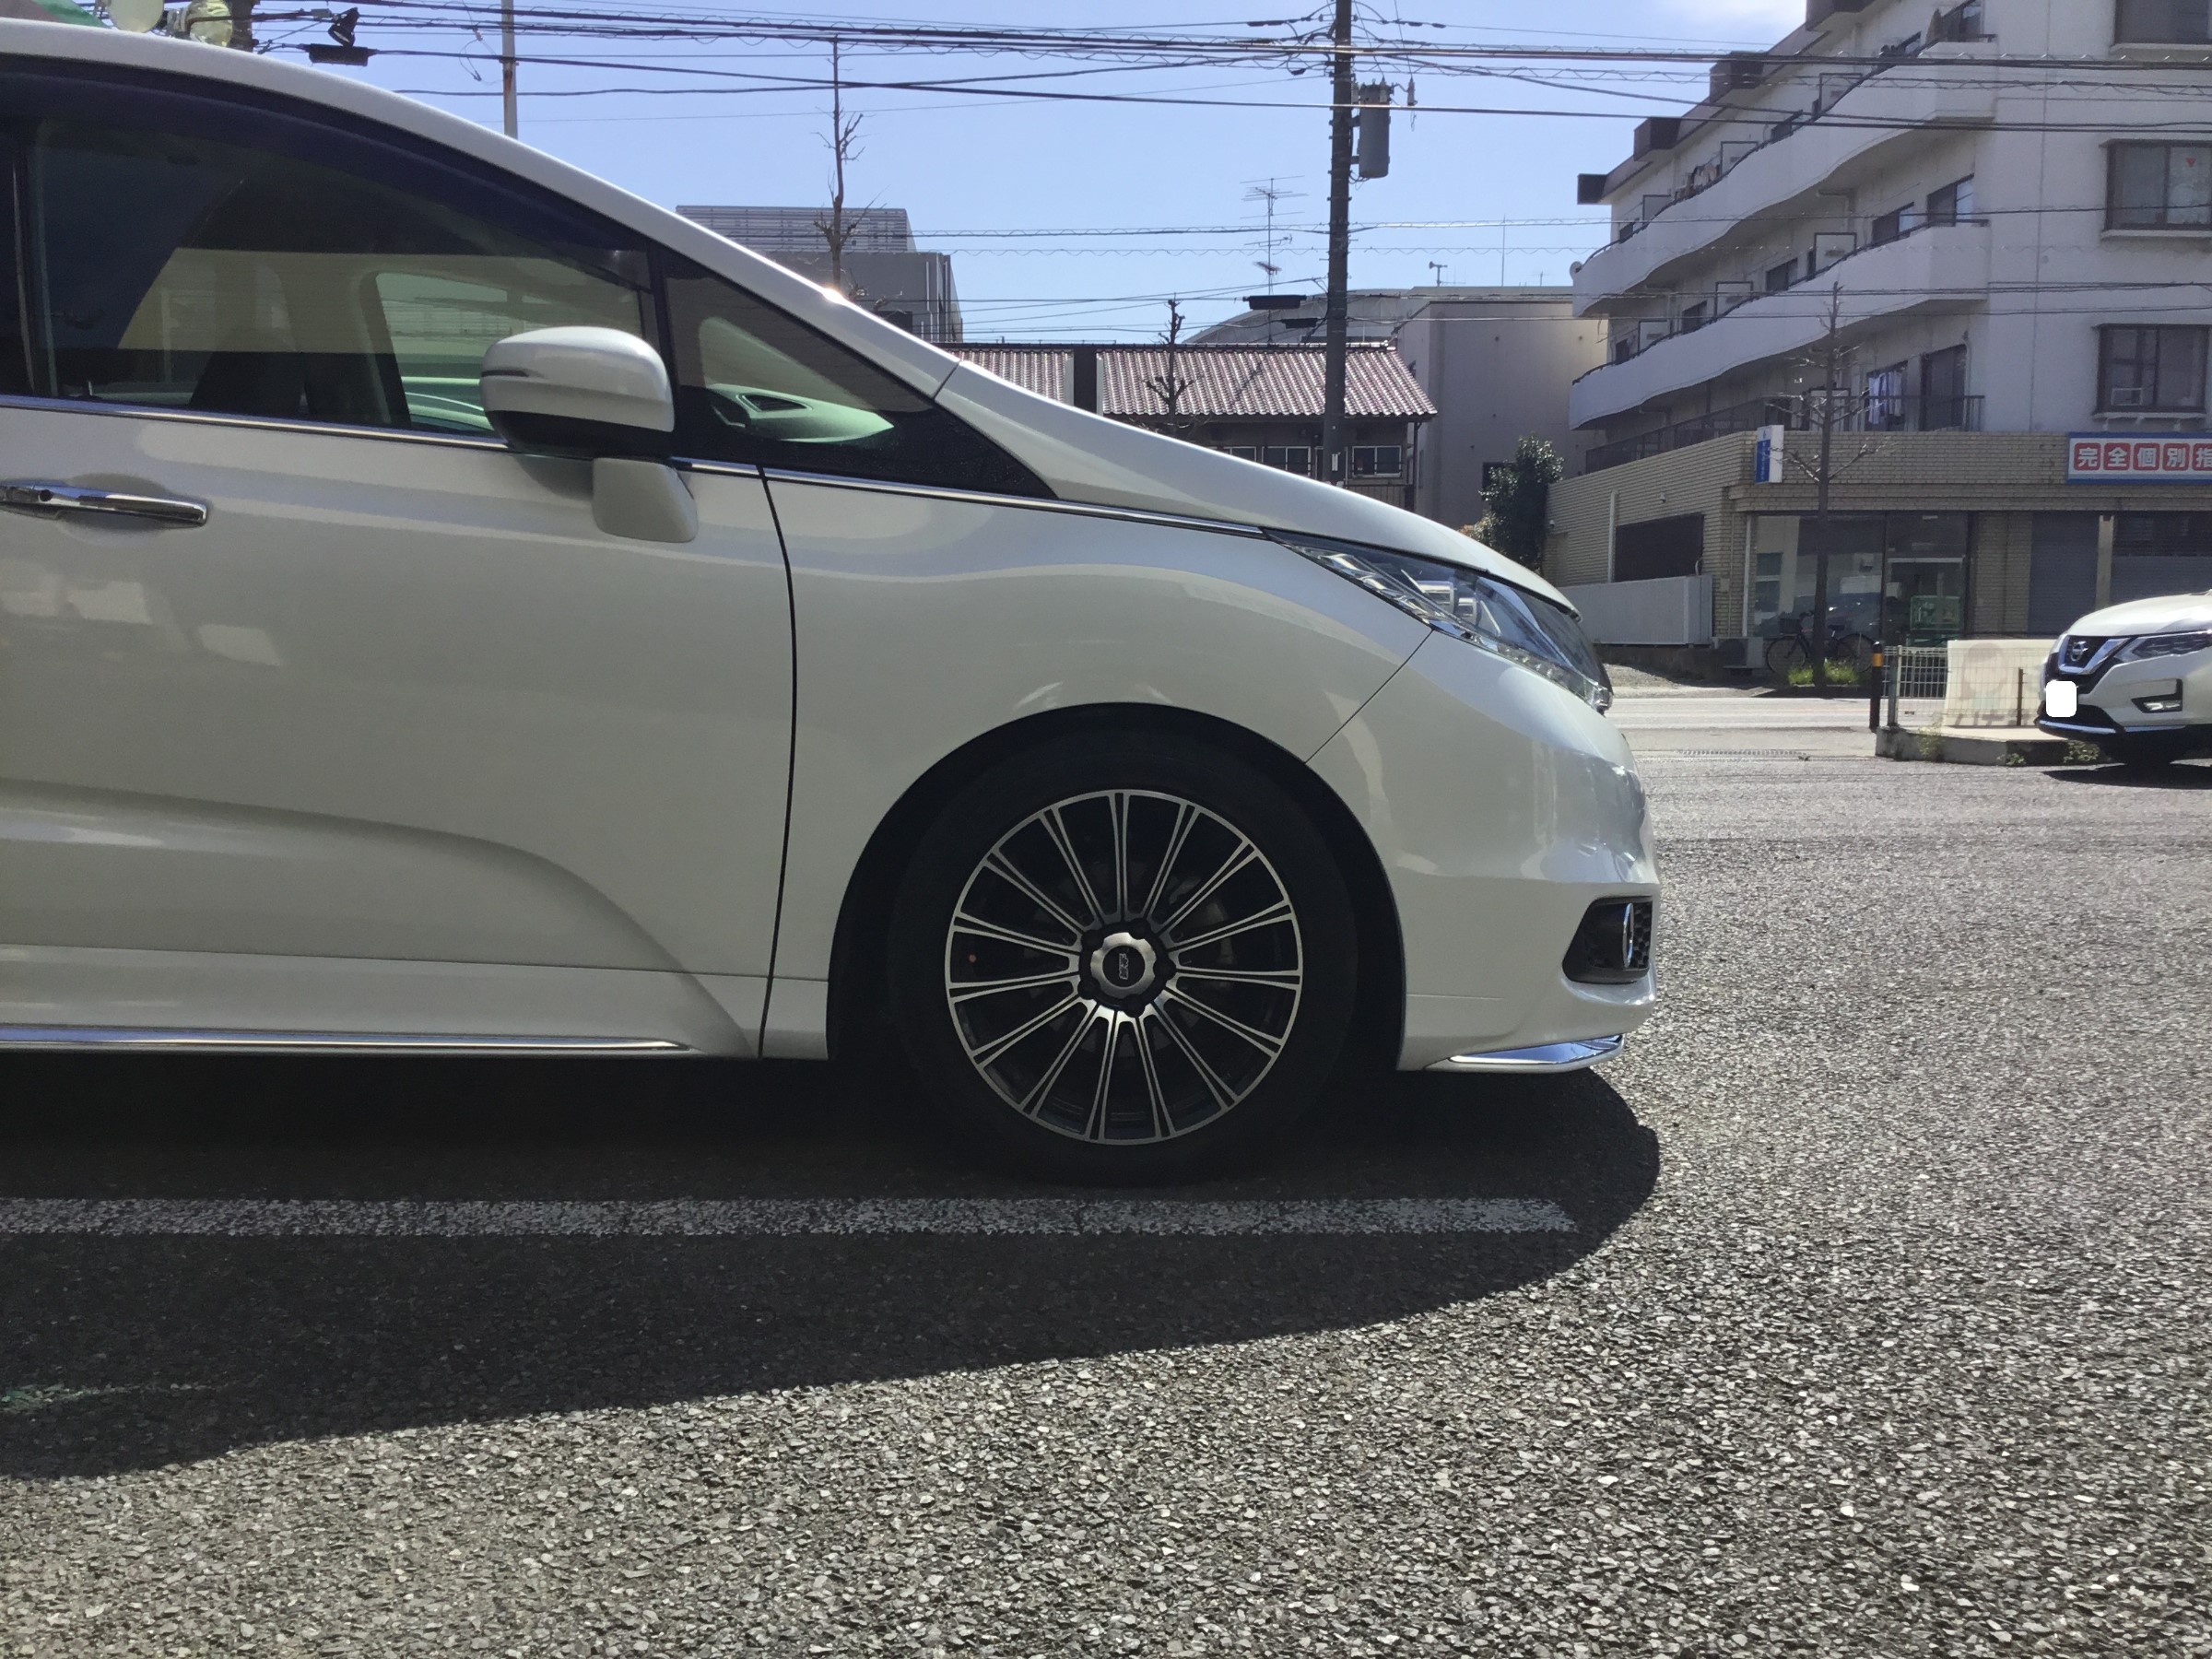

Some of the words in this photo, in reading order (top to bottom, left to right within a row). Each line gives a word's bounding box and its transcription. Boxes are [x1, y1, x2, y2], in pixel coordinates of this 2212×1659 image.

[2077, 446, 2212, 468] 完全個別指
